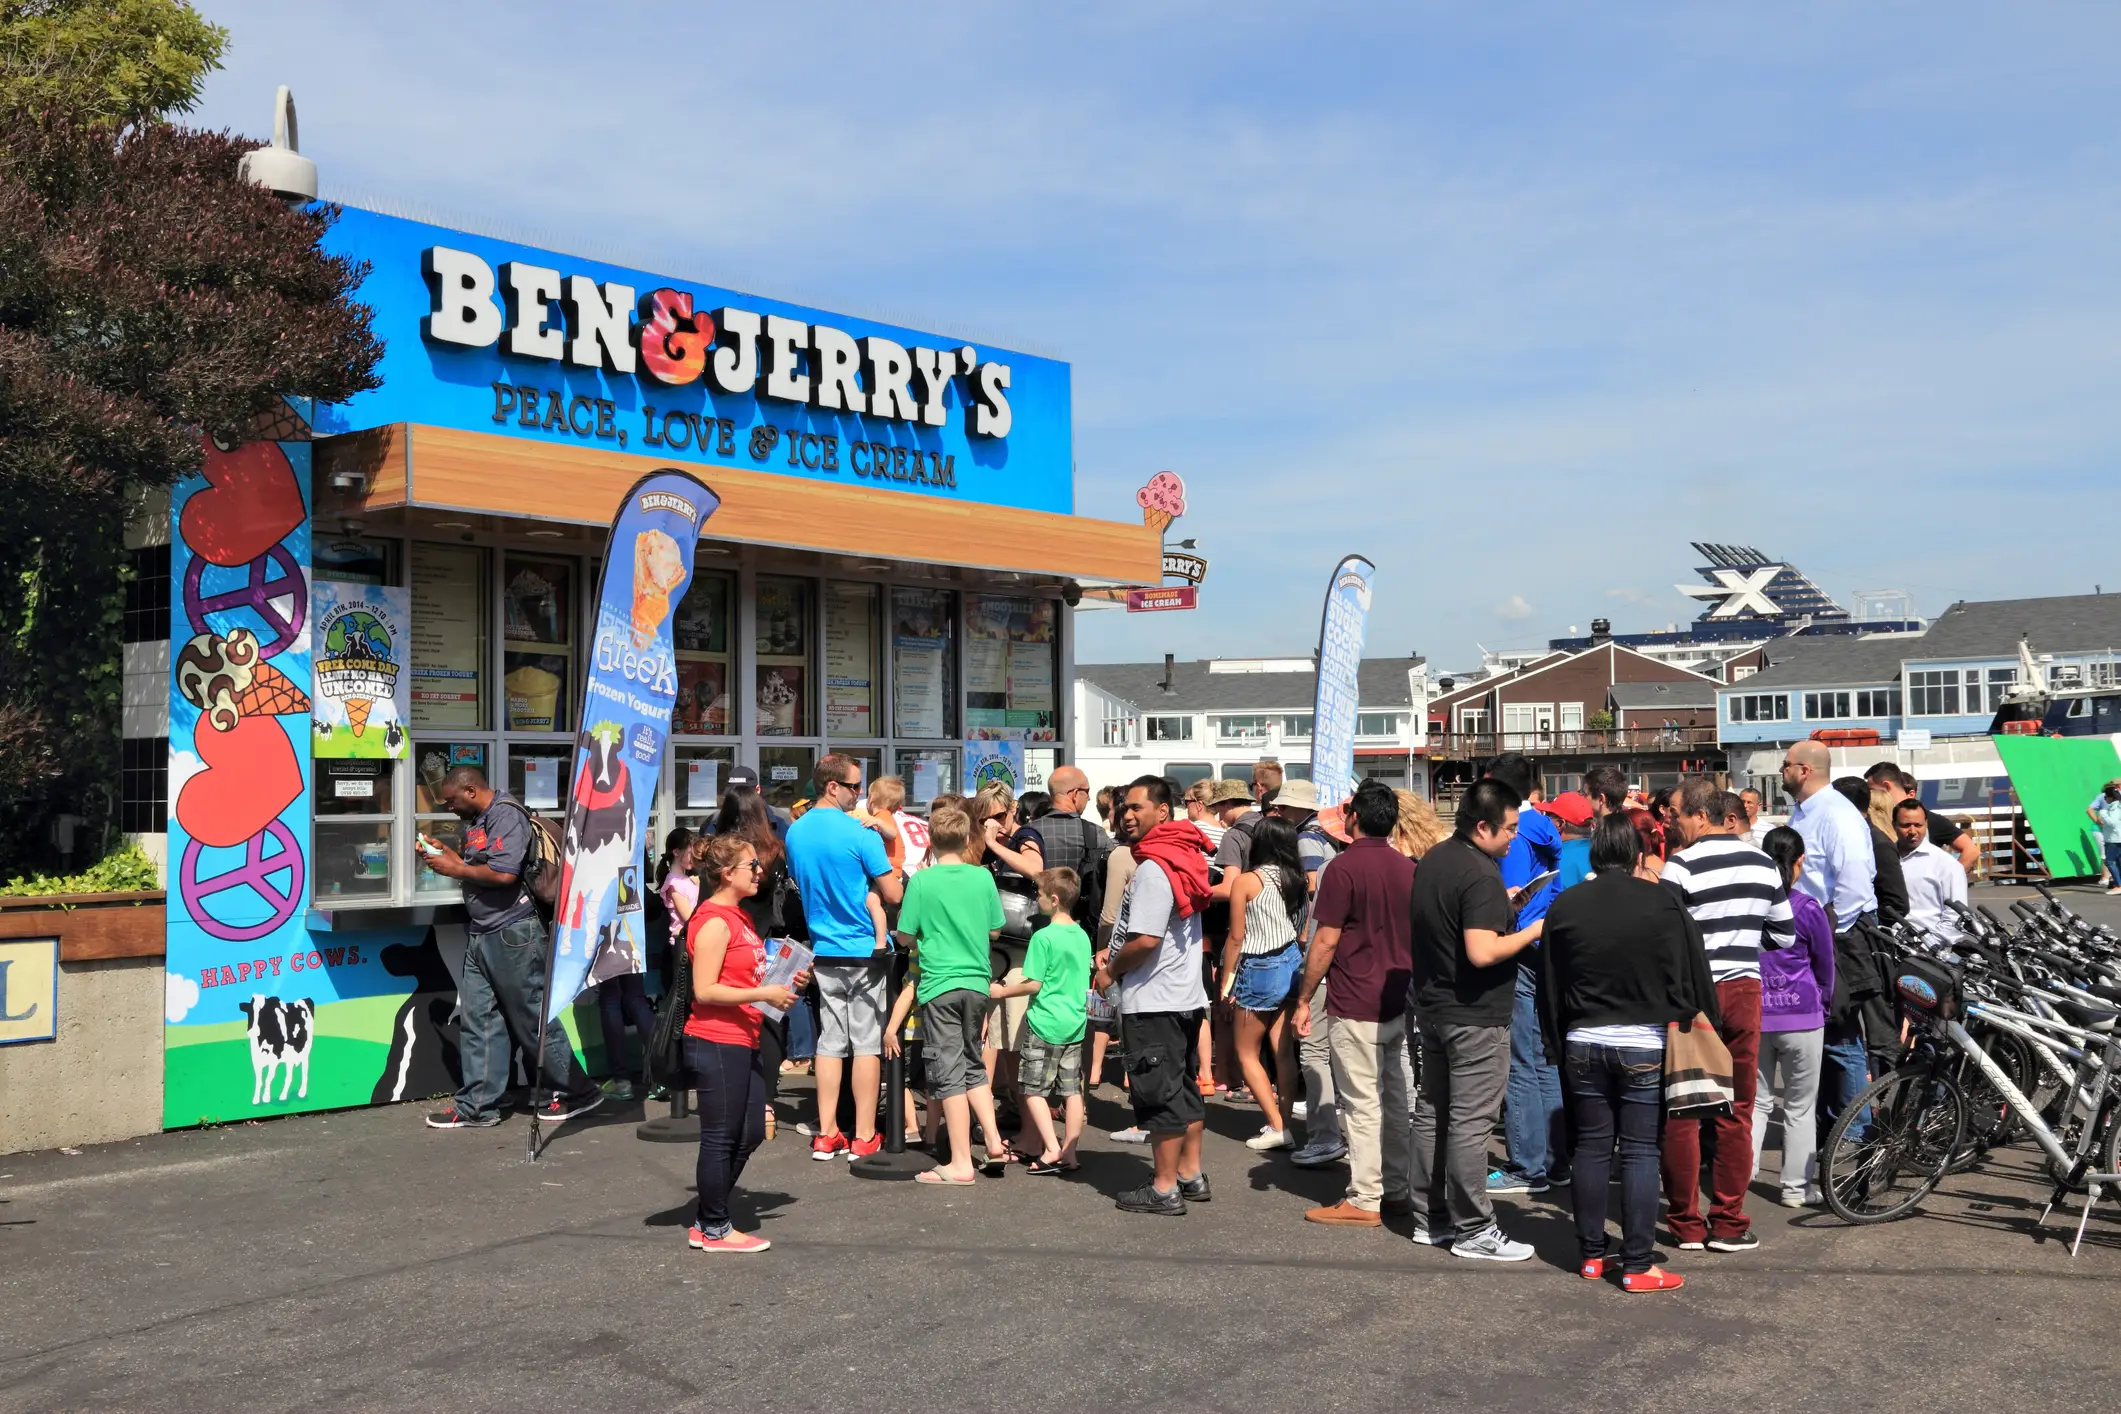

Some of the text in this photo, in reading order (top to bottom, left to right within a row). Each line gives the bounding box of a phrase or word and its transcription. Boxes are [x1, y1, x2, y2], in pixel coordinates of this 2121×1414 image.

[428, 245, 1011, 438] BEN&JERRY'S
[492, 382, 958, 487] PEACE, LOVE & ICE CREAM
[641, 494, 697, 524] BEN&JERRY'S
[1163, 557, 1202, 577] ERRY'S
[1144, 591, 1178, 600] HOMEMADE
[1154, 598, 1182, 607] CREAM
[319, 612, 336, 631] APRIL
[349, 600, 364, 609] 2014
[371, 605, 378, 614] 12
[378, 610, 386, 620] TO
[388, 624, 398, 636] PM
[317, 659, 399, 675] FREE CONE DAY
[320, 670, 396, 684] LEAVE NO HAND
[597, 631, 675, 696] Greek
[322, 680, 394, 698] UNCONED
[588, 676, 671, 721] Frozen Yogurt
[636, 732, 656, 747] really
[903, 821, 930, 848] 8
[201, 946, 368, 989] HAPPY COWS.
